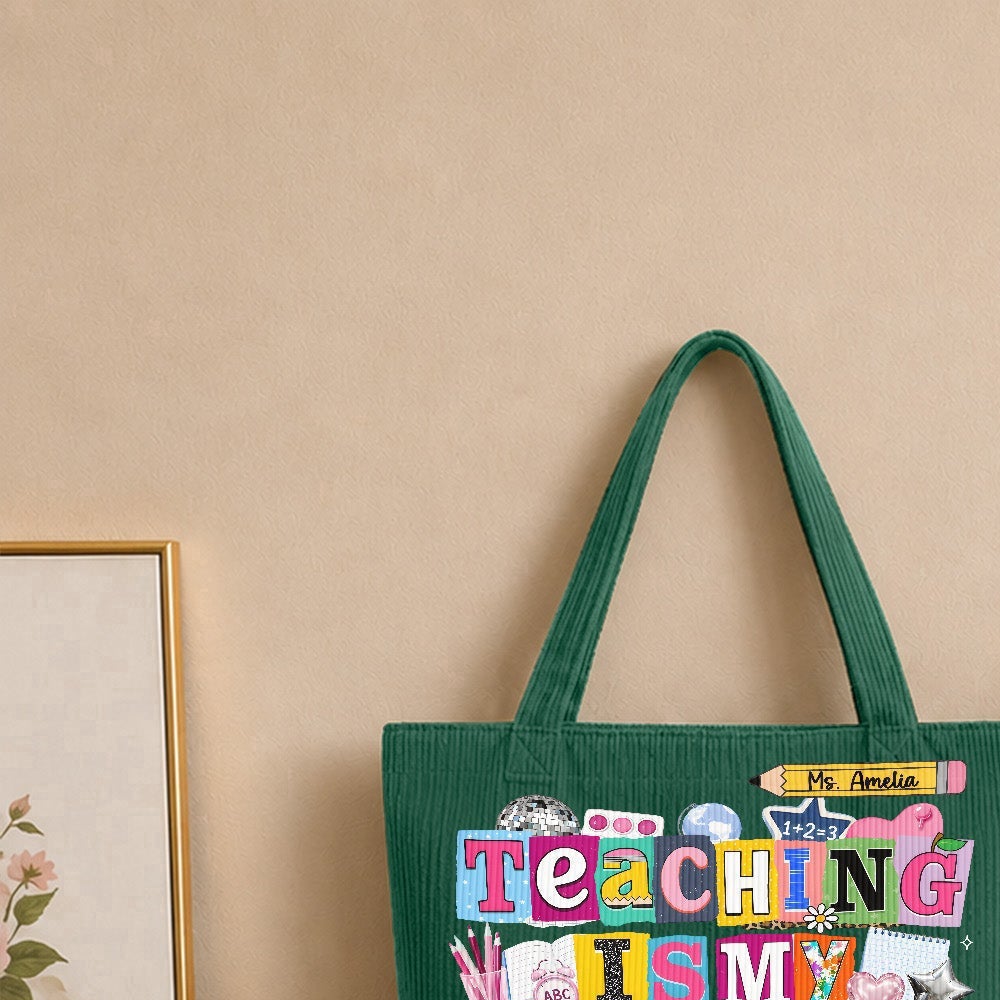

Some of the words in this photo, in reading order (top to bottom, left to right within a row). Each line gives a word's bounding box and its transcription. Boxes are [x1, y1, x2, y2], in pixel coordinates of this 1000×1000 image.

[808, 770, 839, 791] Ms.
[850, 770, 920, 790] Amelia
[782, 820, 838, 840] 1+2=3
